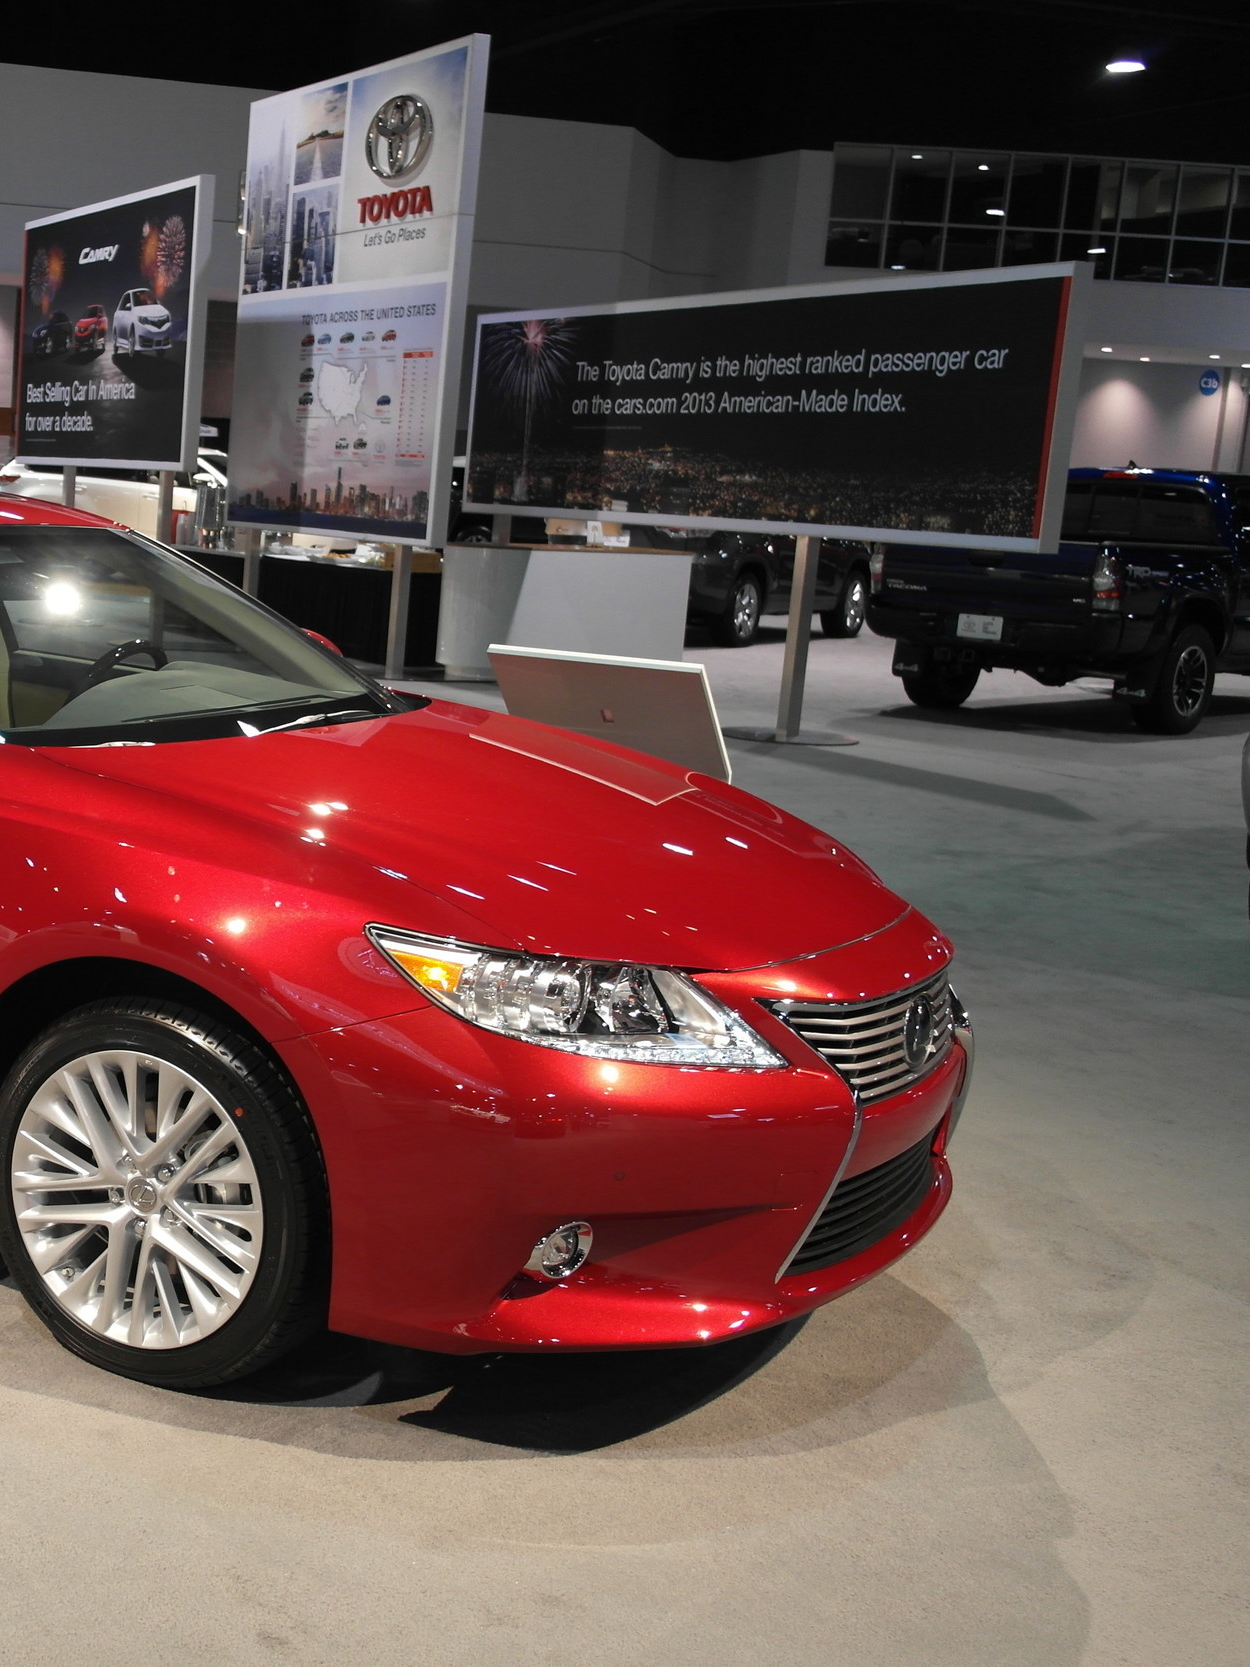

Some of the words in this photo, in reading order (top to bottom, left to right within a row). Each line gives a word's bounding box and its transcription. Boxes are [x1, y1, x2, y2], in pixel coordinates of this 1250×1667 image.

[357, 185, 433, 224] TOYOTA
[363, 232, 383, 247] Let's
[384, 230, 396, 244] Go
[397, 228, 427, 242] Places
[78, 244, 119, 265] CAMRY
[301, 313, 327, 325] TOYOTA
[329, 311, 358, 324] ACROSS
[360, 309, 375, 321] THE
[376, 306, 405, 320] UNITED
[406, 303, 436, 316] STATES
[576, 361, 599, 381] The
[603, 360, 645, 386] Toyota
[649, 358, 696, 384] Camry
[699, 356, 712, 378] is
[715, 355, 739, 378] the
[743, 353, 802, 382] highest
[805, 348, 866, 374] ranked
[868, 350, 970, 378] passenger
[974, 348, 1009, 370] car
[26, 383, 44, 403] Best
[45, 381, 70, 407] Selling
[72, 380, 88, 402] Car
[98, 378, 135, 400] America
[572, 398, 588, 415] on
[591, 394, 611, 414] the
[614, 396, 677, 415] cars.com
[680, 391, 715, 414] 2013
[718, 388, 848, 413] American-Made
[853, 387, 906, 413] Index.
[25, 412, 36, 431] for
[36, 415, 54, 431] over
[54, 416, 61, 431] a
[61, 411, 94, 431] decade.
